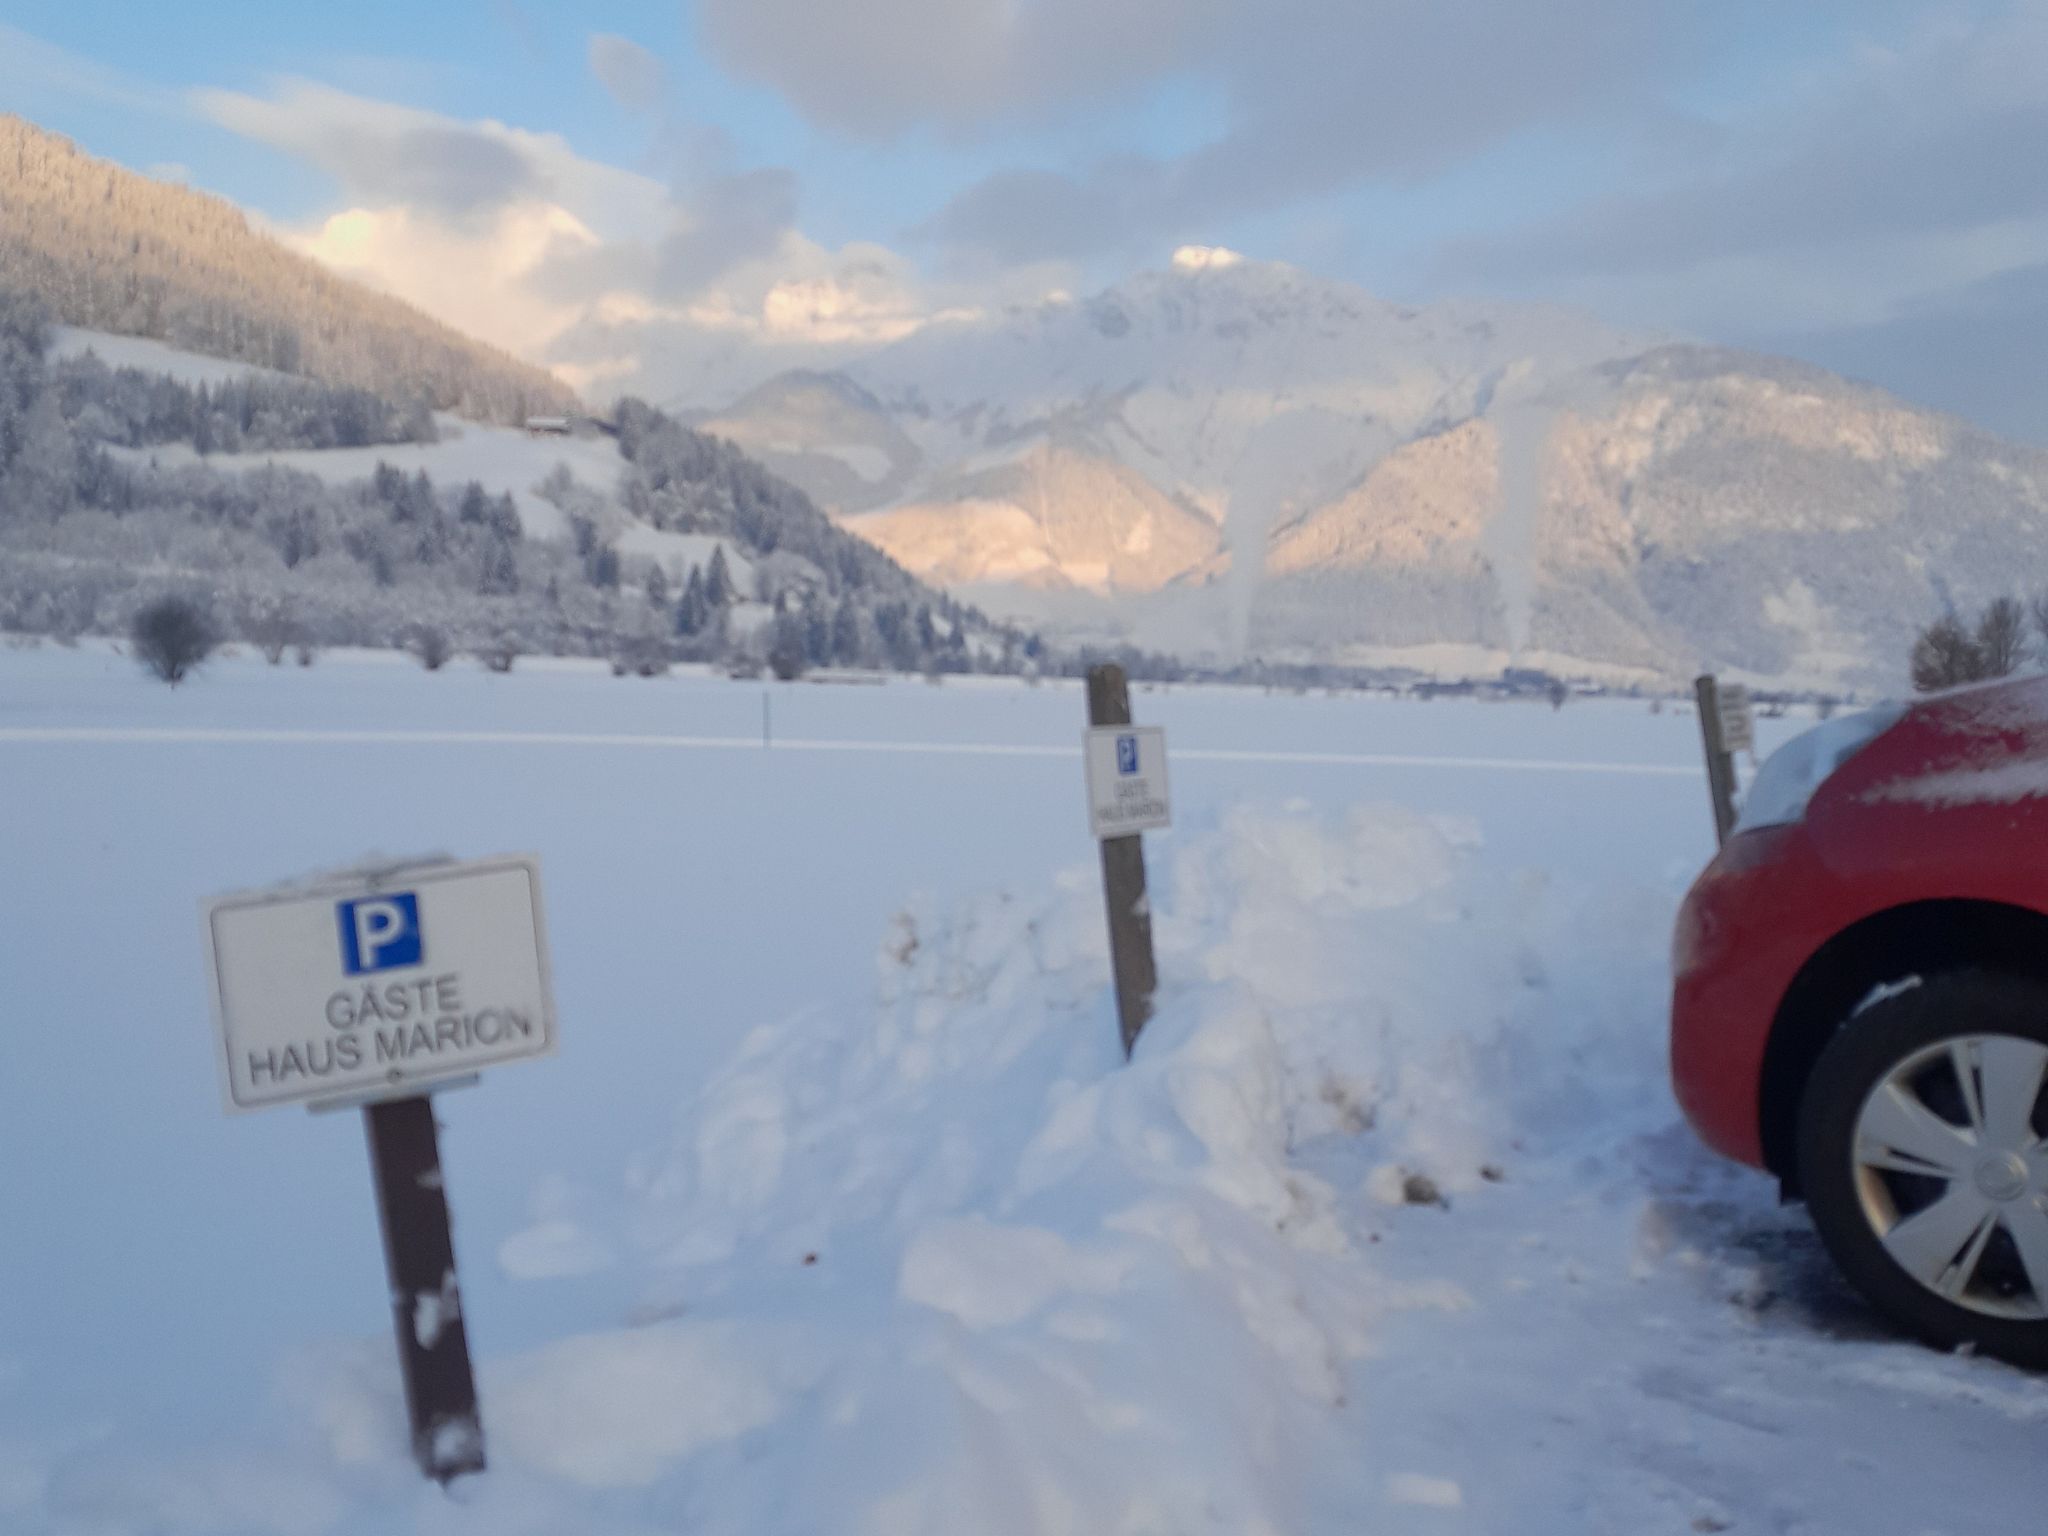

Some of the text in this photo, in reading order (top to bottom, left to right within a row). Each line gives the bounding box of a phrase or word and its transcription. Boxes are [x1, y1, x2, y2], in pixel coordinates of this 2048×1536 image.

[353, 902, 404, 969] P
[325, 973, 461, 1031] GÄSTE
[248, 1008, 533, 1085] HAUS MARION
